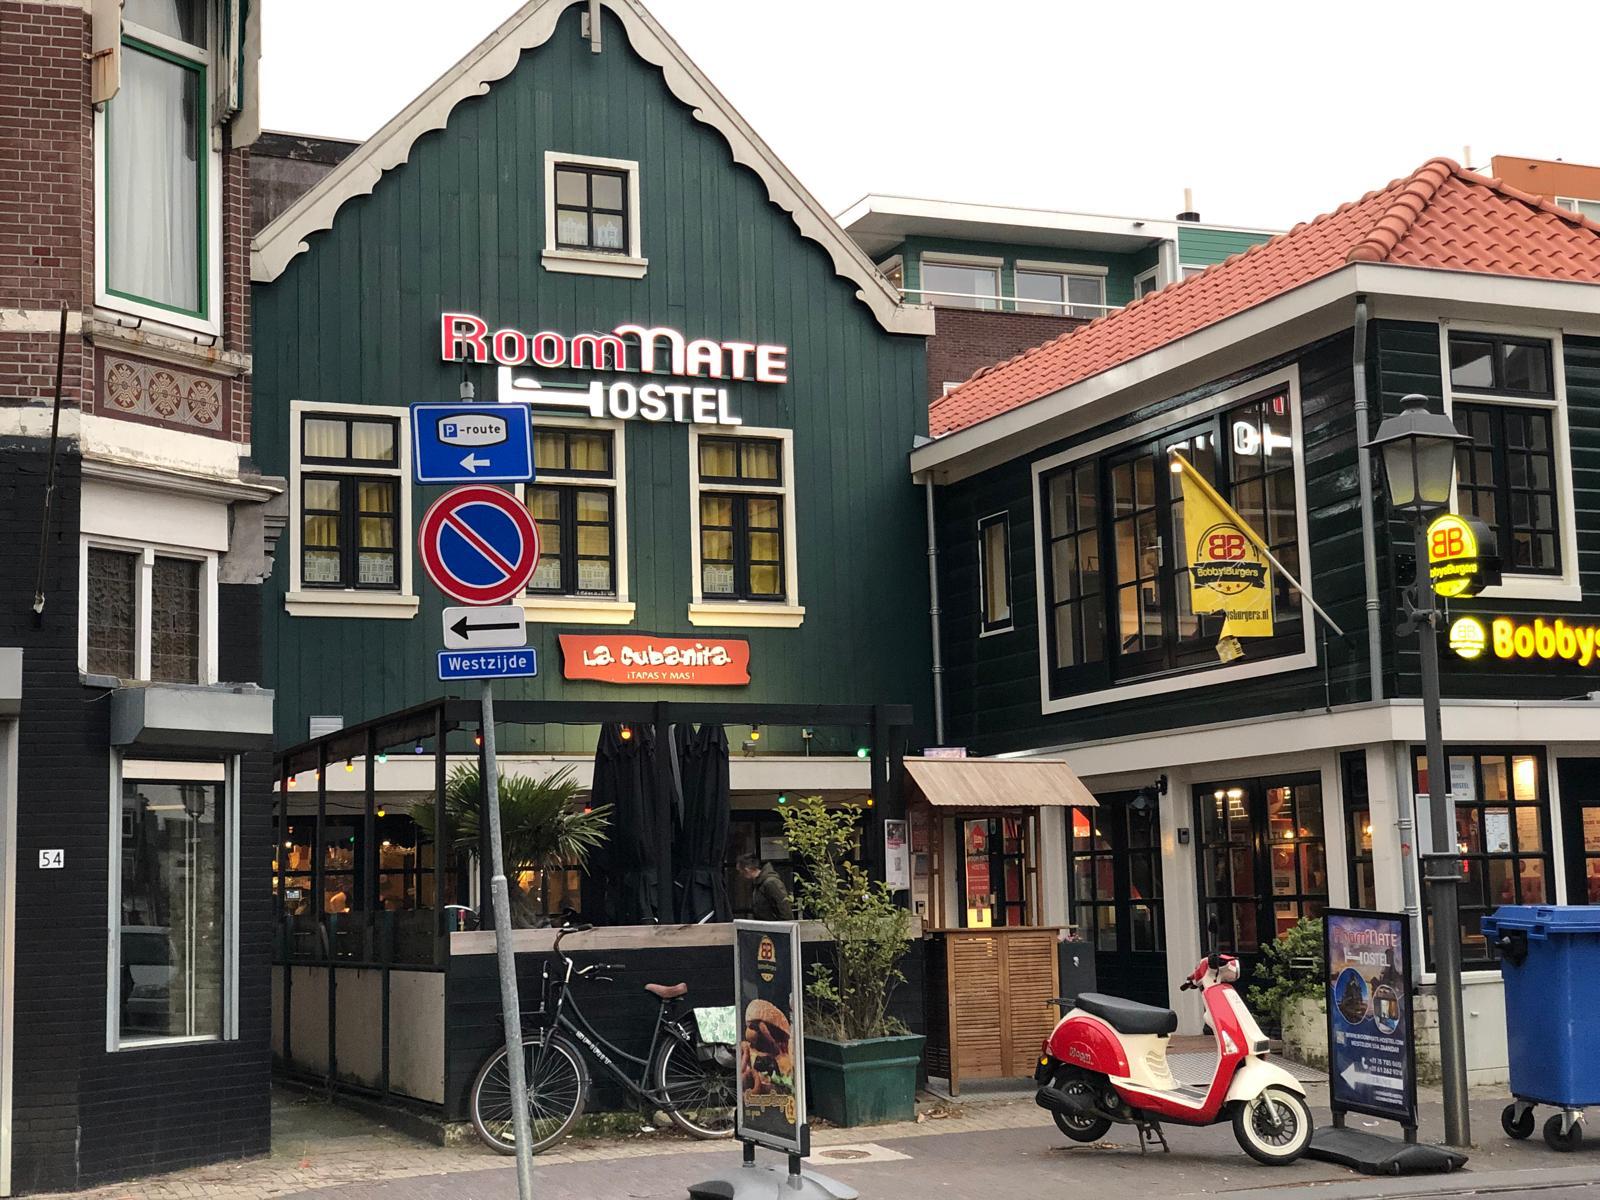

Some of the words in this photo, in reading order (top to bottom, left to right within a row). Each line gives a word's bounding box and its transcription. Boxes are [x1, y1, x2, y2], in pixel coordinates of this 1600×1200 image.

[498, 366, 742, 425] HOSTEL
[1208, 534, 1246, 560] BB
[1432, 527, 1464, 559] BB
[448, 655, 527, 673] Westzijde
[662, 672, 668, 680] Y
[41, 851, 62, 867] 54
